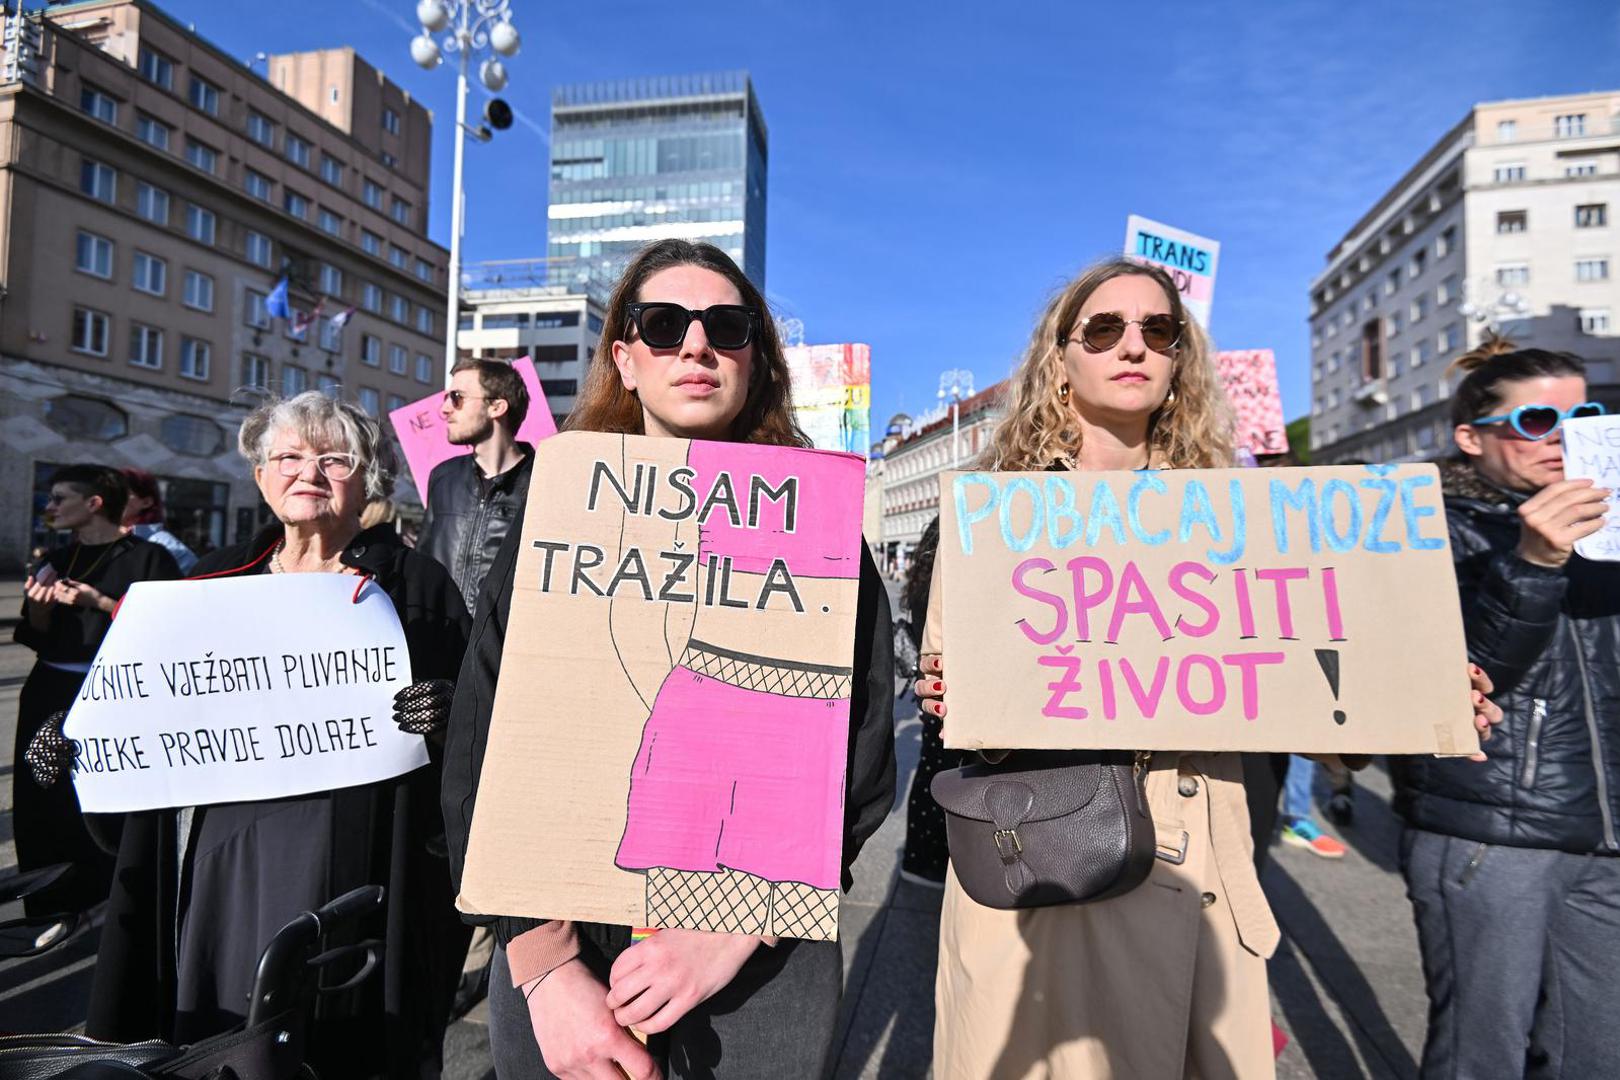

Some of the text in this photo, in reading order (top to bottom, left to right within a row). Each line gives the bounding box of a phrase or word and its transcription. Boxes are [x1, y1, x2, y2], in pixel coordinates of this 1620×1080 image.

[1138, 231, 1207, 272] TRANS
[408, 411, 434, 434] NE
[587, 461, 797, 533] NISAM
[952, 464, 1446, 565] POBAČAJ MOŽE
[1011, 556, 1347, 646] SPASITI
[160, 651, 272, 697] VJEŽBATI
[281, 647, 396, 690] PLIVANJE
[69, 716, 378, 774] RIJEKE PRAVDE DOLAZE
